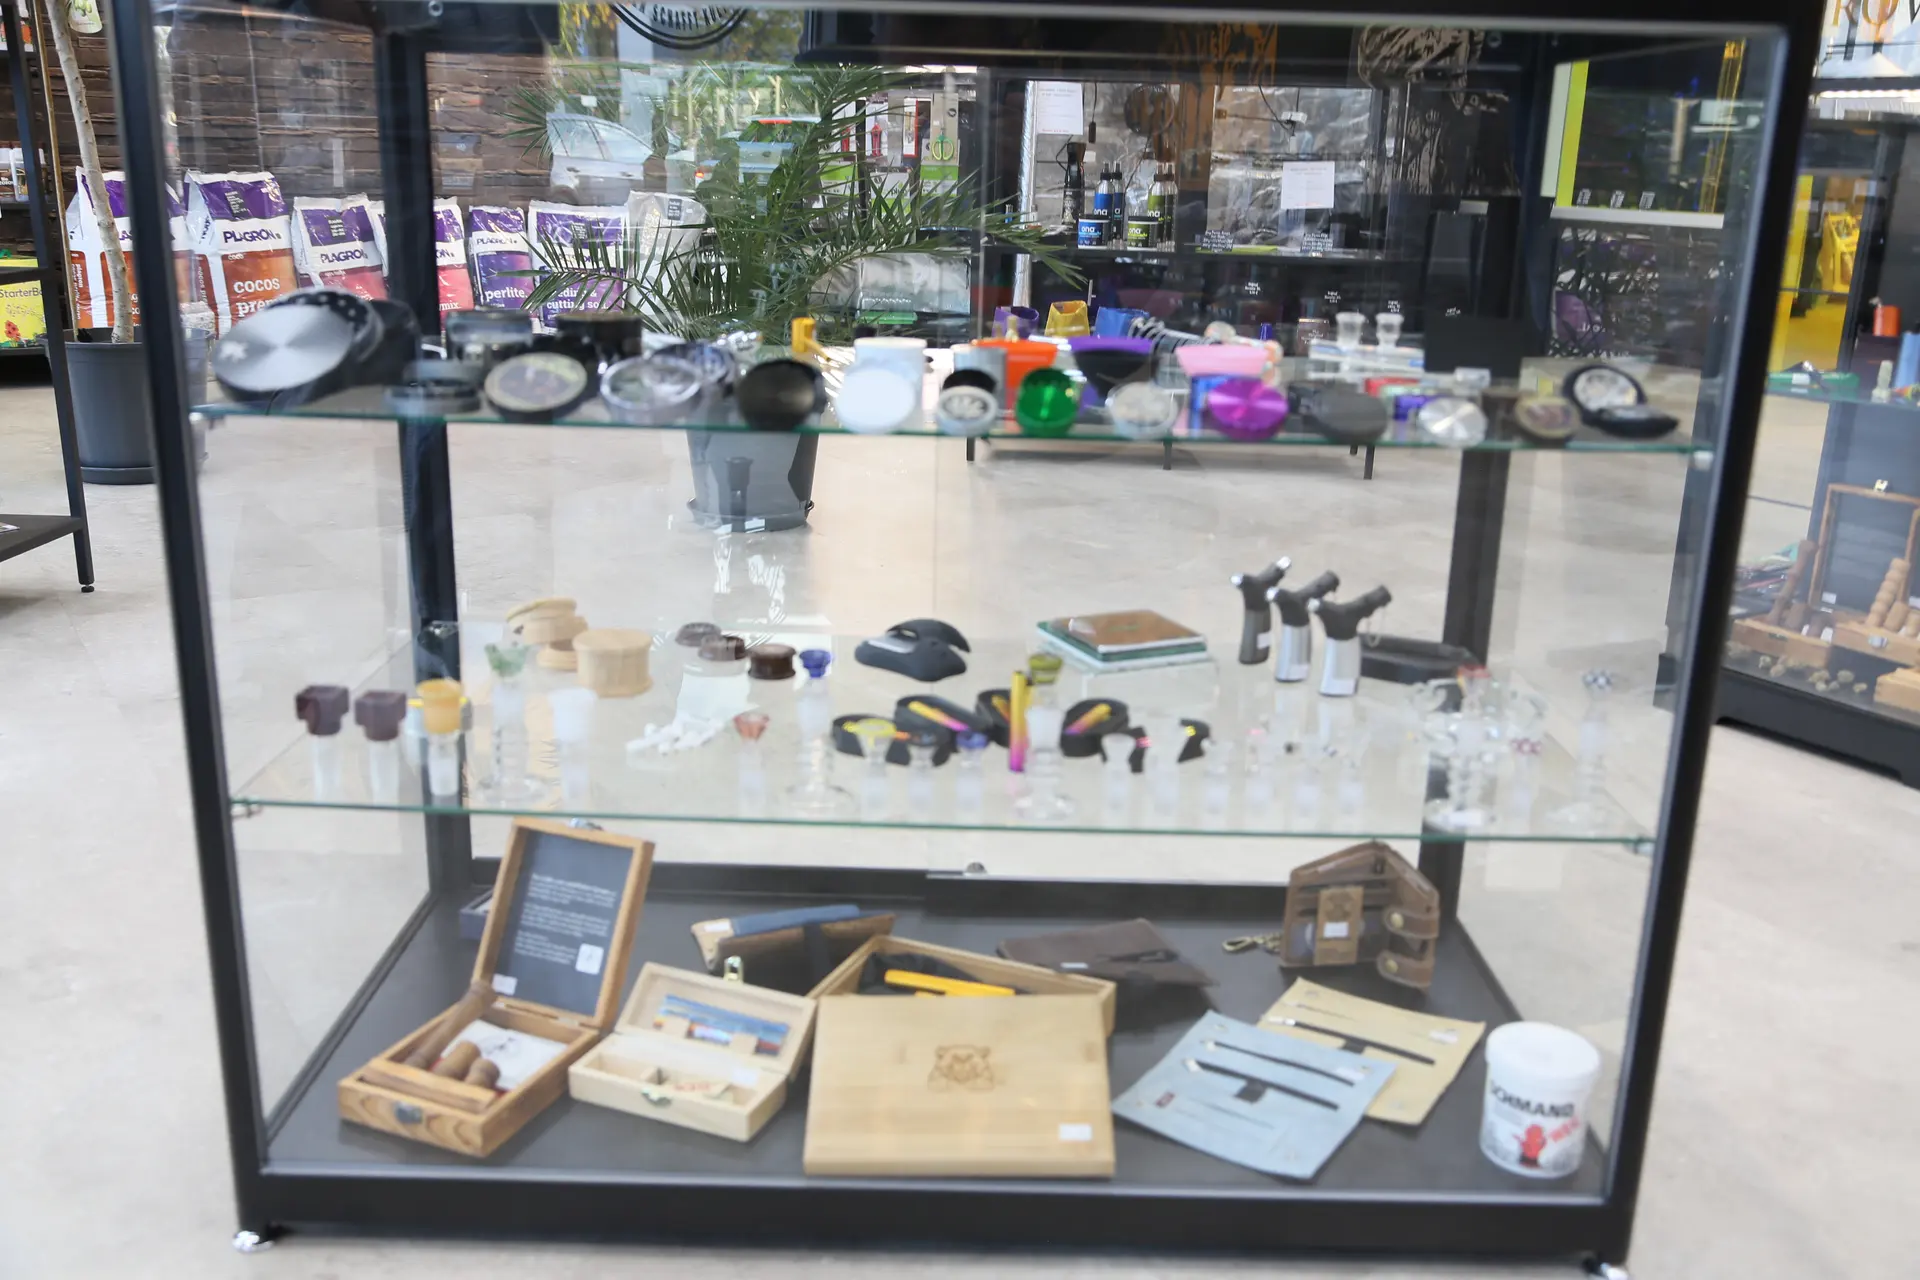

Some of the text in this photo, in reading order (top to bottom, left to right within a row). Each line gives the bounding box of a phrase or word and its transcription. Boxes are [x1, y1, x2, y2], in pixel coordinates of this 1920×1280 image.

[223, 229, 276, 243] PLAGRON
[321, 249, 363, 264] PLAGRON
[485, 285, 529, 301] perlite.
